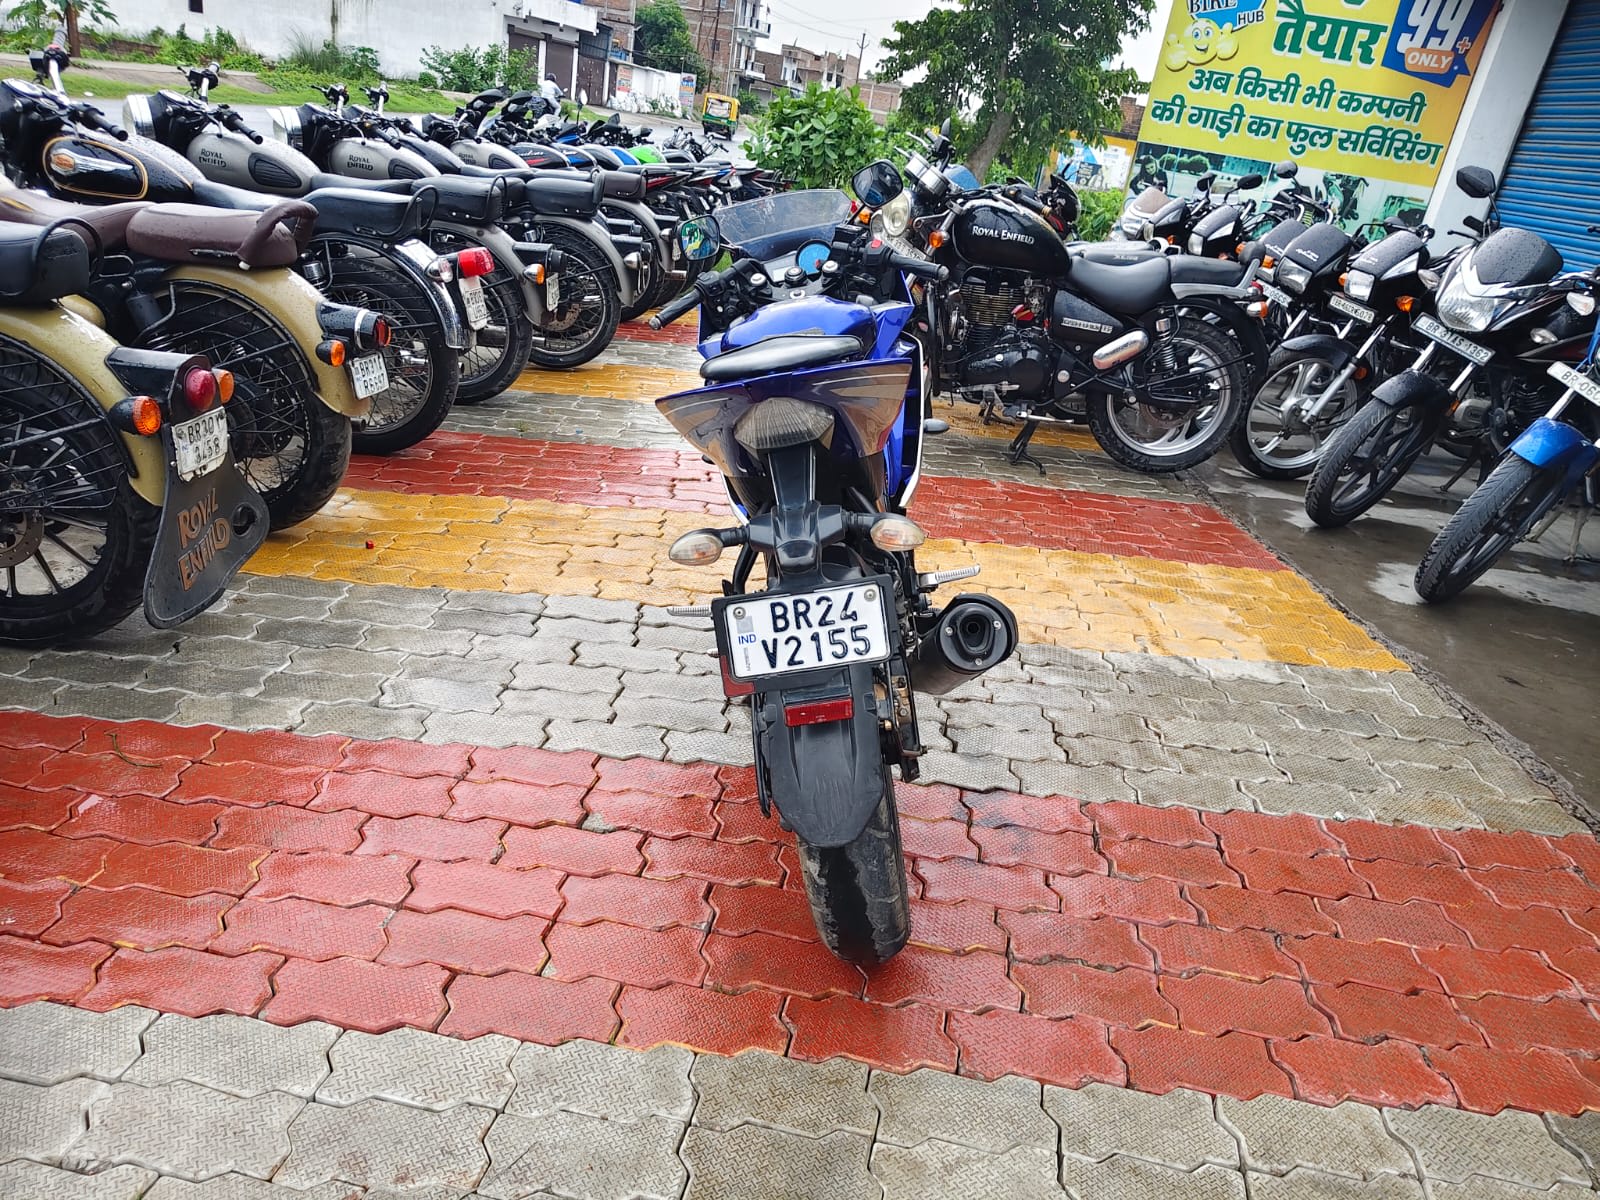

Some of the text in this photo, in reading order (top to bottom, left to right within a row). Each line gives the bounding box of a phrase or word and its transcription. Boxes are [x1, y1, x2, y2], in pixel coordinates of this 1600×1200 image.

[1238, 10, 1264, 25] HUB
[1272, 0, 1388, 66] तैयार
[1406, 51, 1453, 70] ONLY
[1189, 67, 1427, 124] अब किसी भी कम्पनी
[1151, 95, 1444, 166] की गाड़ी का फुल सर्विसिंग
[199, 156, 227, 168] ENFIELD
[200, 148, 223, 159] ROYAL
[348, 154, 371, 164] ROYAL
[347, 161, 374, 171] ENFIELD
[972, 225, 1035, 244] ROYAL ENFIELD
[1425, 322, 1440, 334] BR
[1466, 343, 1489, 361] 1362
[1561, 371, 1579, 385] BR
[177, 487, 219, 550] ROYAL
[770, 591, 858, 633] BR24
[738, 633, 757, 645] IND
[761, 624, 871, 669] V2155
